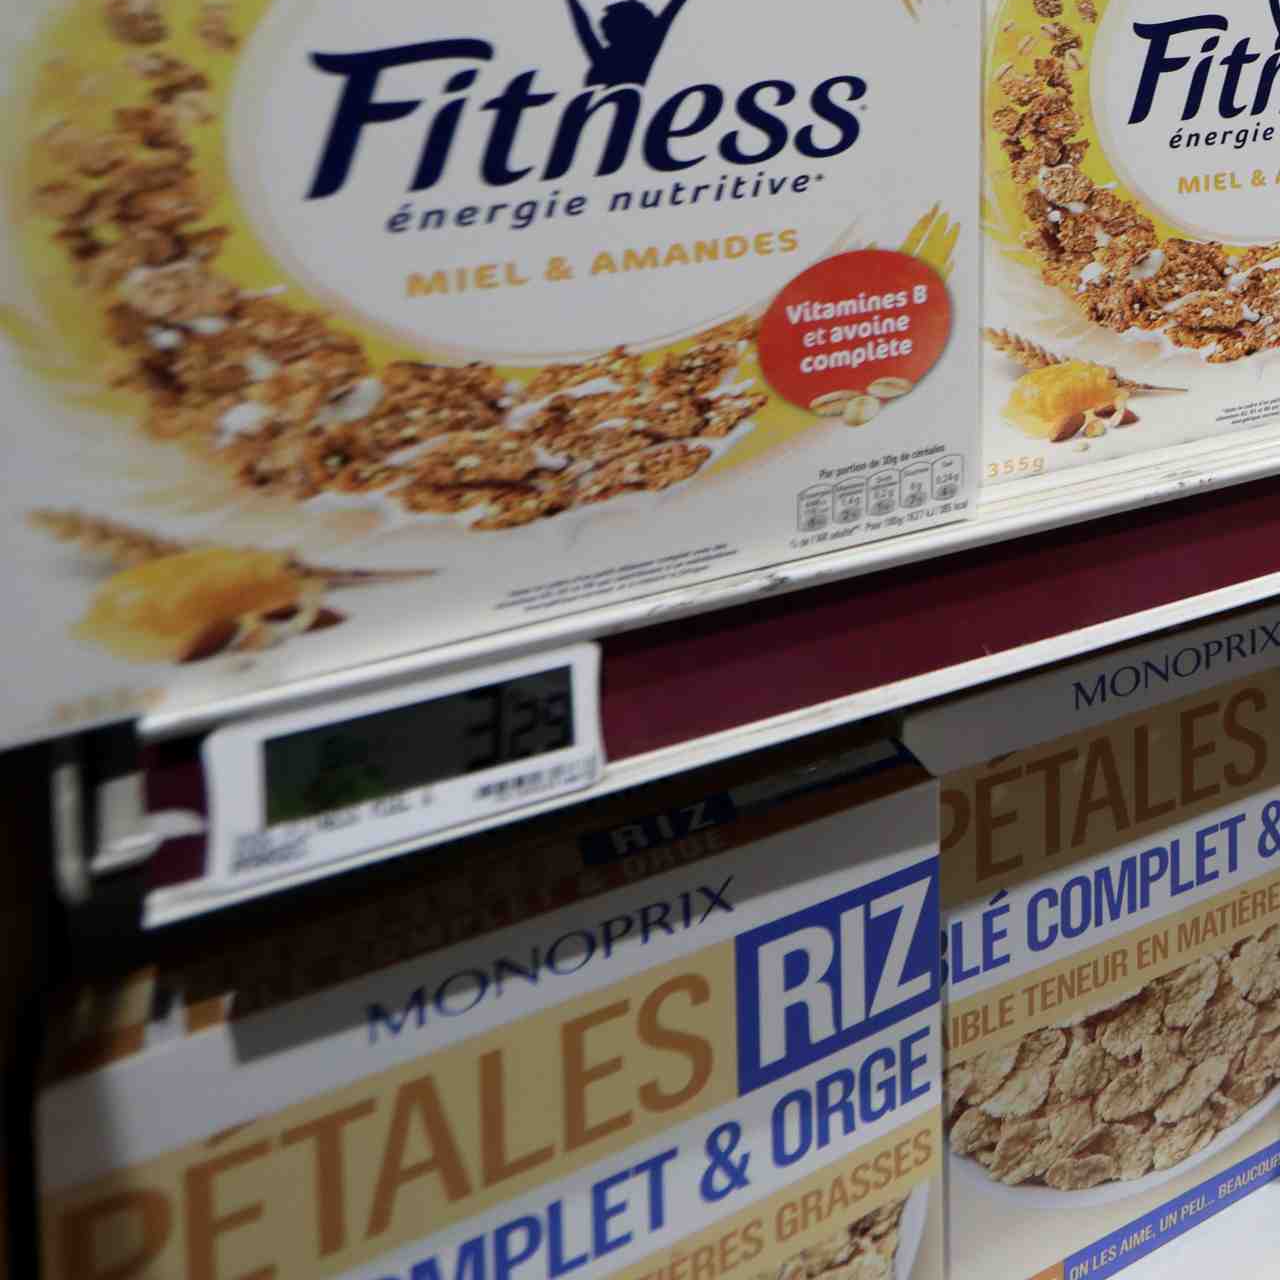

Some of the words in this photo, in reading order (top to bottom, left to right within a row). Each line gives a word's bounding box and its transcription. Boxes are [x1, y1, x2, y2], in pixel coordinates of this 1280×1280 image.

[304, 37, 869, 201] Fitness
[1168, 116, 1275, 151] énergie
[385, 186, 588, 237] énergie
[1177, 171, 1242, 195] MIEL
[1252, 170, 1268, 187] &
[406, 264, 528, 299] MIEL
[544, 254, 575, 283] &
[590, 227, 800, 276] AMANDES
[785, 287, 908, 326] Vitamines
[912, 283, 928, 305] B
[802, 326, 827, 347] et
[829, 314, 911, 344] avoine
[799, 334, 914, 375] complète
[986, 455, 1045, 480] 355g
[608, 797, 716, 855] RIZ
[1026, 812, 1247, 954] COMPLET
[366, 875, 737, 1047] MONOPRIX
[946, 994, 1016, 1051] IBLE
[1022, 951, 1128, 1018] TENEUR
[1136, 933, 1169, 970] EN
[55, 972, 716, 1280] PÉTALES
[756, 874, 937, 1074] RIZ
[697, 1119, 753, 1204] &
[769, 1024, 933, 1163] ORGE
[774, 1131, 935, 1252] GRASSES
[1091, 1246, 1118, 1271] LES
[1159, 1213, 1178, 1233] UN
